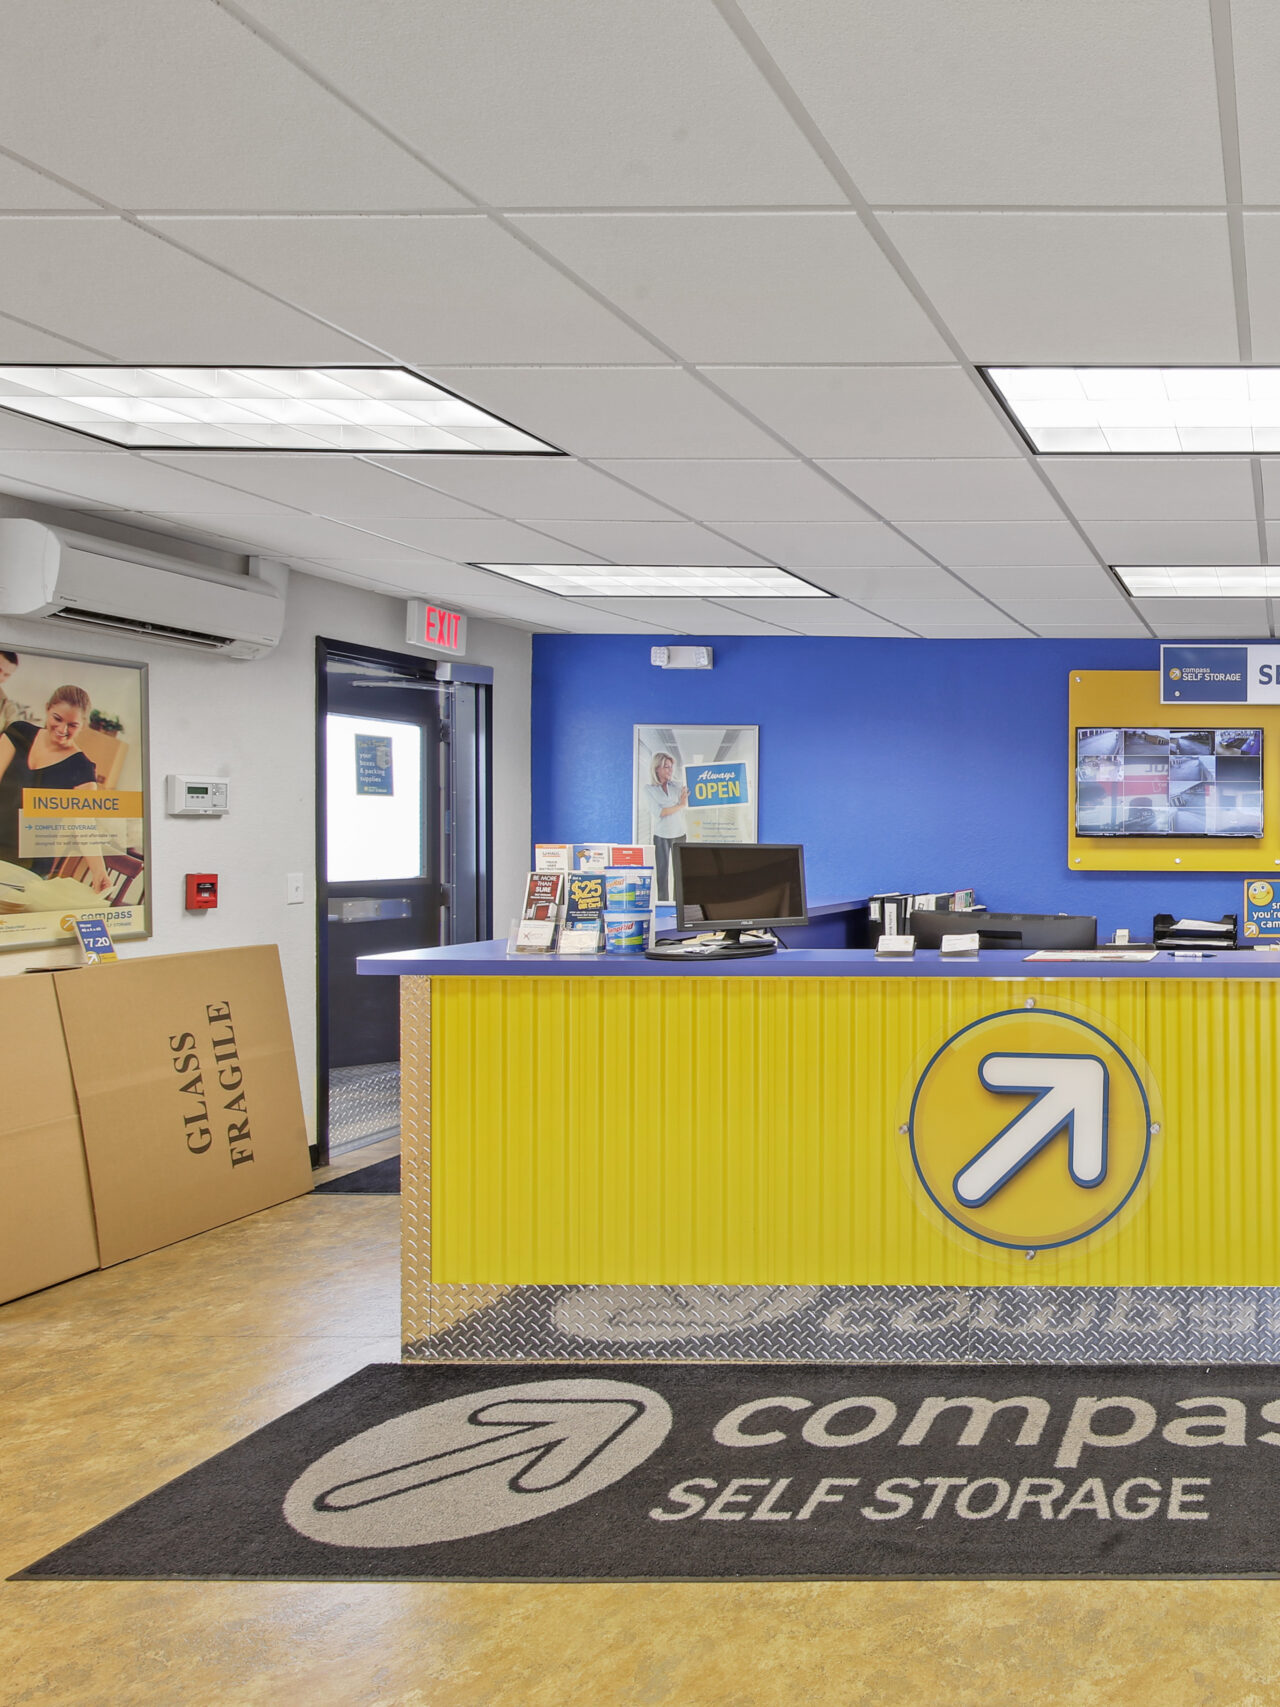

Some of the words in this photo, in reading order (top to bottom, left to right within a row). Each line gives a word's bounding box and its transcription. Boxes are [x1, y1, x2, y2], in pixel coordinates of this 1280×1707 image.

[425, 606, 461, 649] EXIT
[1182, 668, 1210, 676] compass
[697, 770, 736, 781] Always
[694, 781, 740, 800] OPEN
[33, 796, 119, 810] INSURANCE
[571, 879, 602, 901] $25
[80, 910, 132, 922] compass
[84, 937, 110, 947] $7.20
[168, 1032, 212, 1154] GLASS
[206, 1000, 254, 1169] FRAGILE
[649, 1477, 861, 1520] SELF
[860, 1477, 1212, 1520] STORAGE
